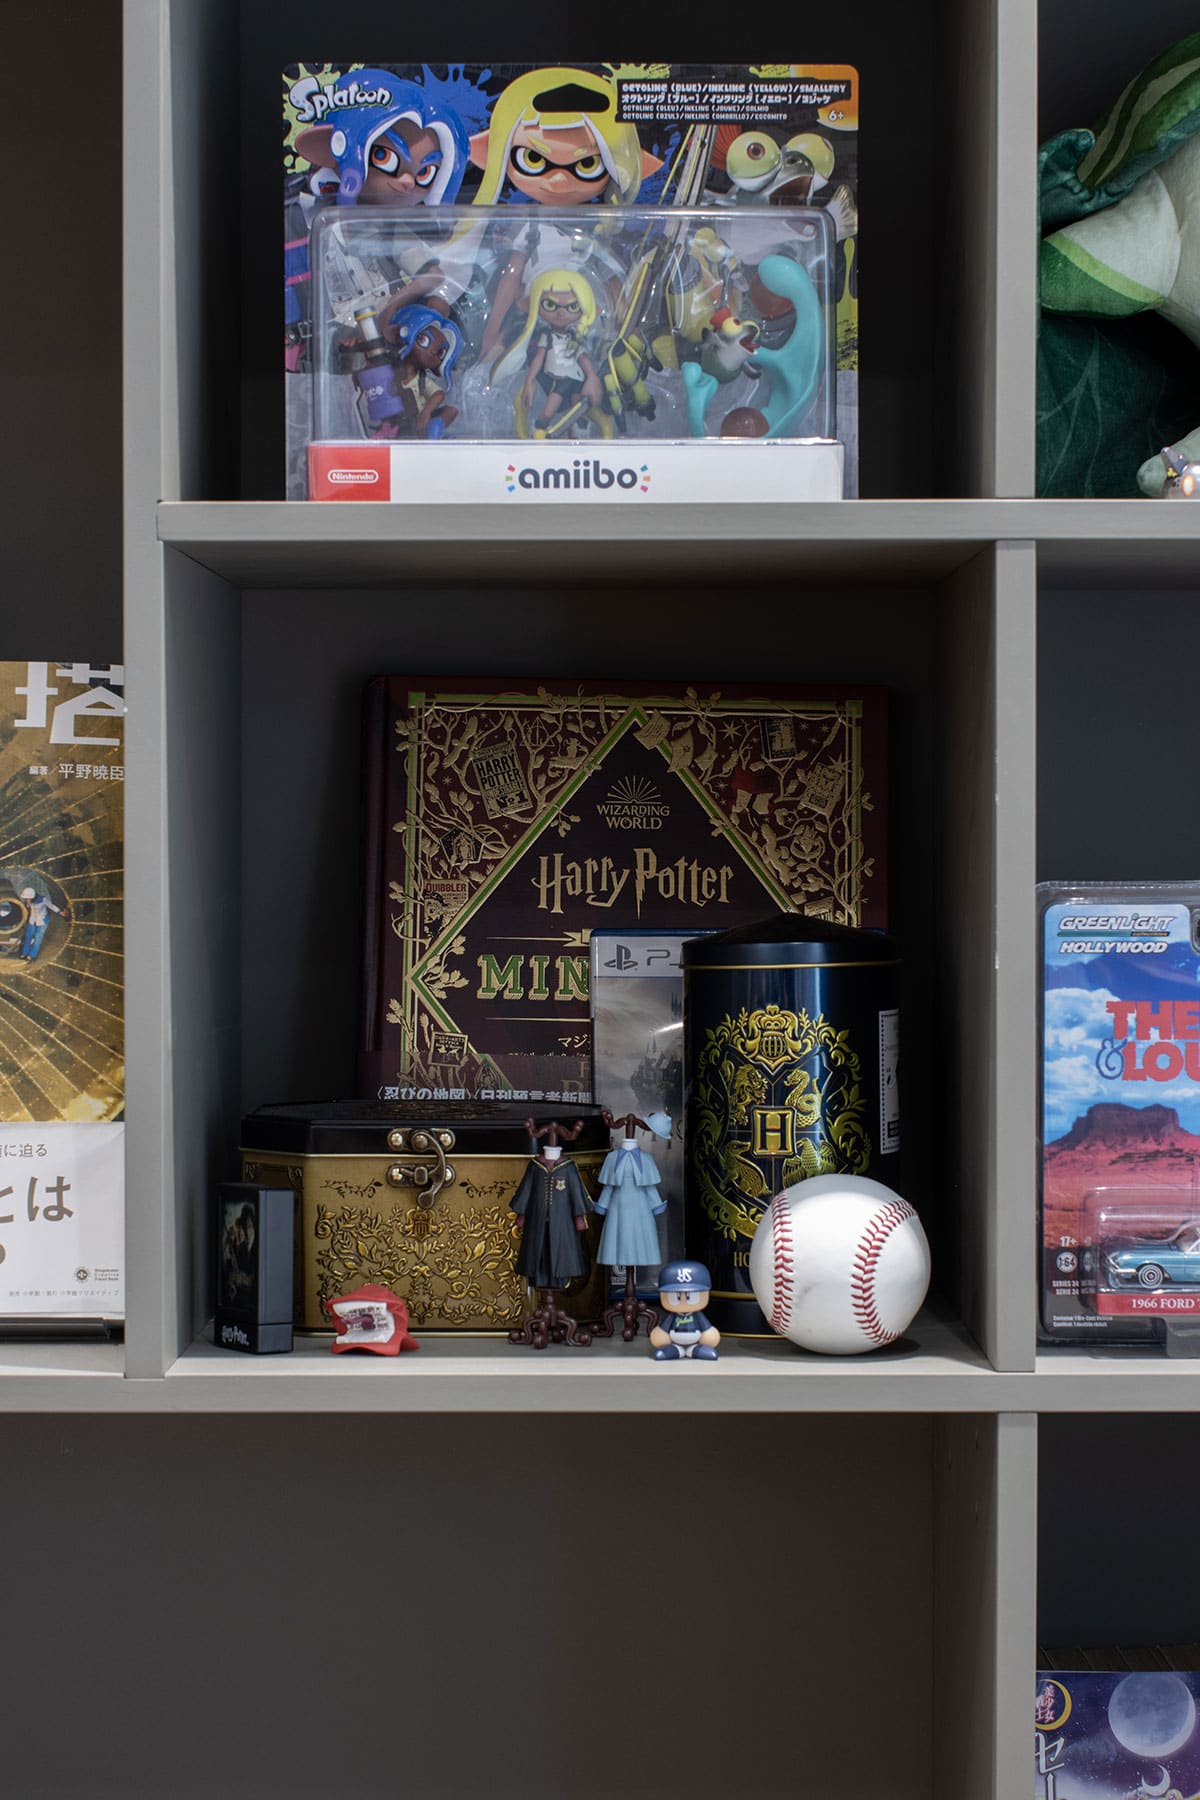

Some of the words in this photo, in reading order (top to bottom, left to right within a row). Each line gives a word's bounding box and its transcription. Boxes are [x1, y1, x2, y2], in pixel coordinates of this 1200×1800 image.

[622, 83, 667, 92] OCTOLING
[290, 76, 391, 121] Splatoon
[828, 110, 844, 121] 6+
[331, 471, 376, 481] Nintendo
[518, 459, 638, 490] amiibo
[476, 754, 517, 777] HARRY
[480, 768, 522, 789] POTTER
[596, 804, 670, 818] WIZARDING
[605, 816, 663, 830] WORLD
[425, 882, 467, 893] QUIBBLER
[531, 852, 631, 914] Harry
[633, 847, 735, 920] Potter
[1059, 941, 1168, 954] HOLLYWOOD
[758, 1113, 787, 1151] H
[0, 1143, 48, 1158] に迫る
[1131, 1298, 1158, 1309] 1966
[1160, 1298, 1196, 1309] FORD
